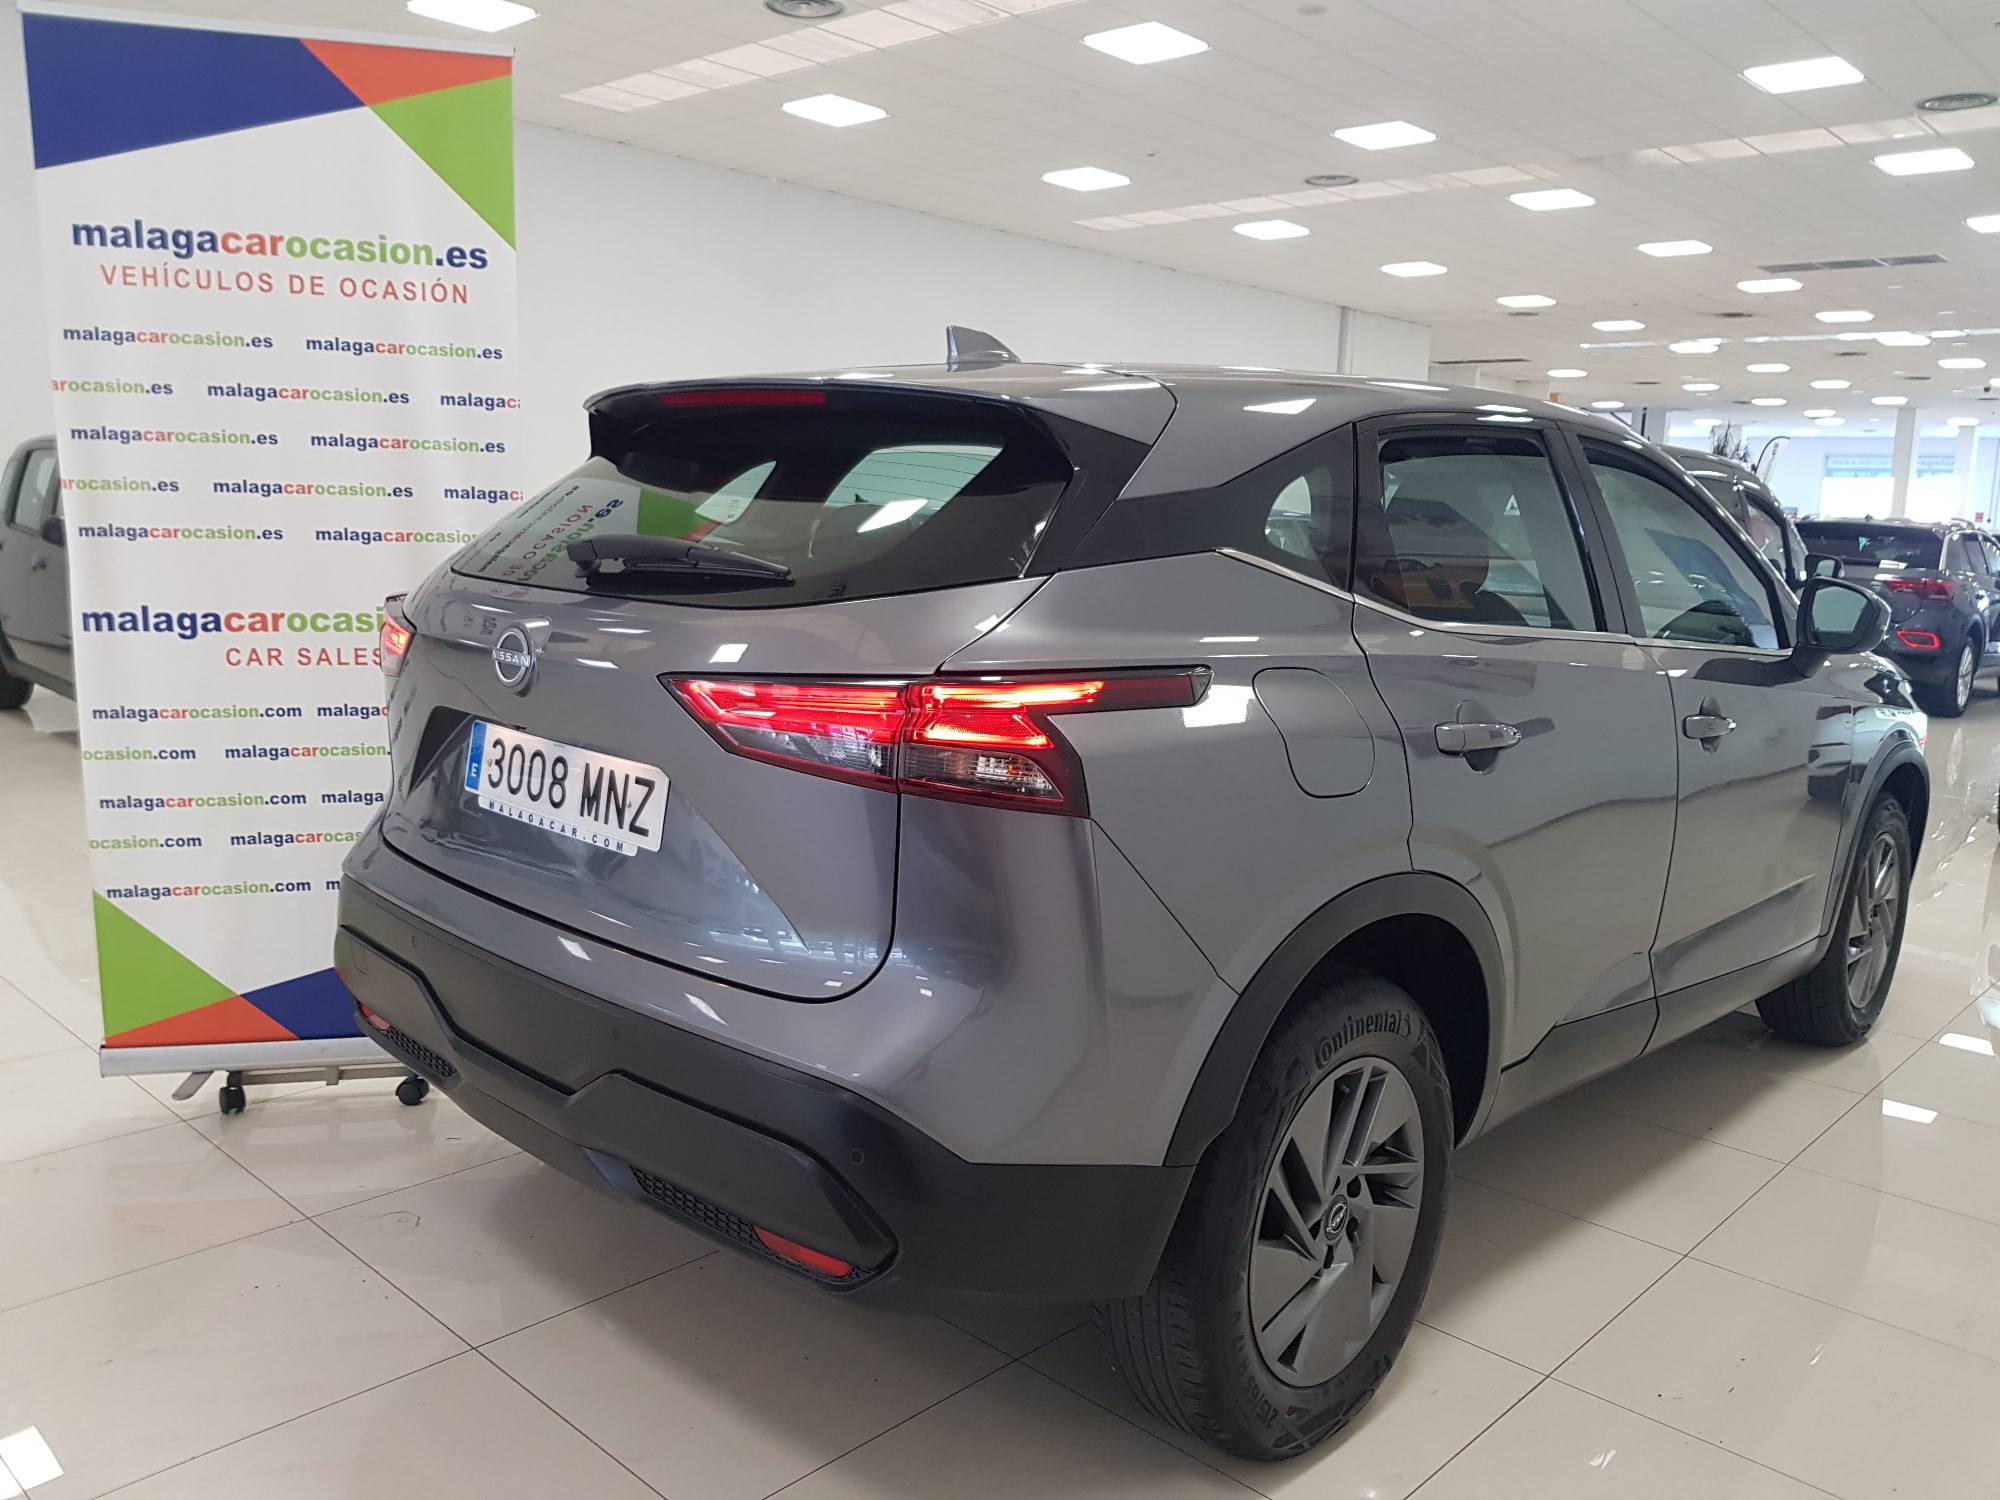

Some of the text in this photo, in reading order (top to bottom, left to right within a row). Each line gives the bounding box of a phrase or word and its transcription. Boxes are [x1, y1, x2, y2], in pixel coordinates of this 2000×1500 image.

[71, 219, 489, 270] malagacarocasion.es
[100, 262, 468, 304] VEHÍCULOS DE OCASIÓN
[63, 325, 274, 349] malagacarocasion.es
[306, 336, 503, 360] malagacarocasion.es
[207, 382, 410, 404] malagacarocasion.es
[70, 425, 279, 445] malagacarocasion.es
[310, 432, 506, 454] malagacarocasion.es
[213, 478, 414, 498] malagacarocasion.es
[78, 523, 284, 542] malagacarocasion.es
[315, 527, 477, 546] malagacarocasio
[225, 647, 381, 668] CAR SALES
[494, 648, 529, 667] NISSAN
[92, 704, 303, 723] malagacarocasion.com
[82, 747, 197, 761] ocasion.com
[471, 763, 478, 777] E
[488, 738, 569, 809] 3008
[579, 762, 656, 838] MNZ
[99, 792, 307, 812] malagacarocasion.com
[488, 800, 624, 853] MALAGACAR.COM
[89, 835, 203, 849] ocasion.com
[106, 882, 312, 900] malagacarocasion.com
[1315, 1009, 1402, 1070] Continental
